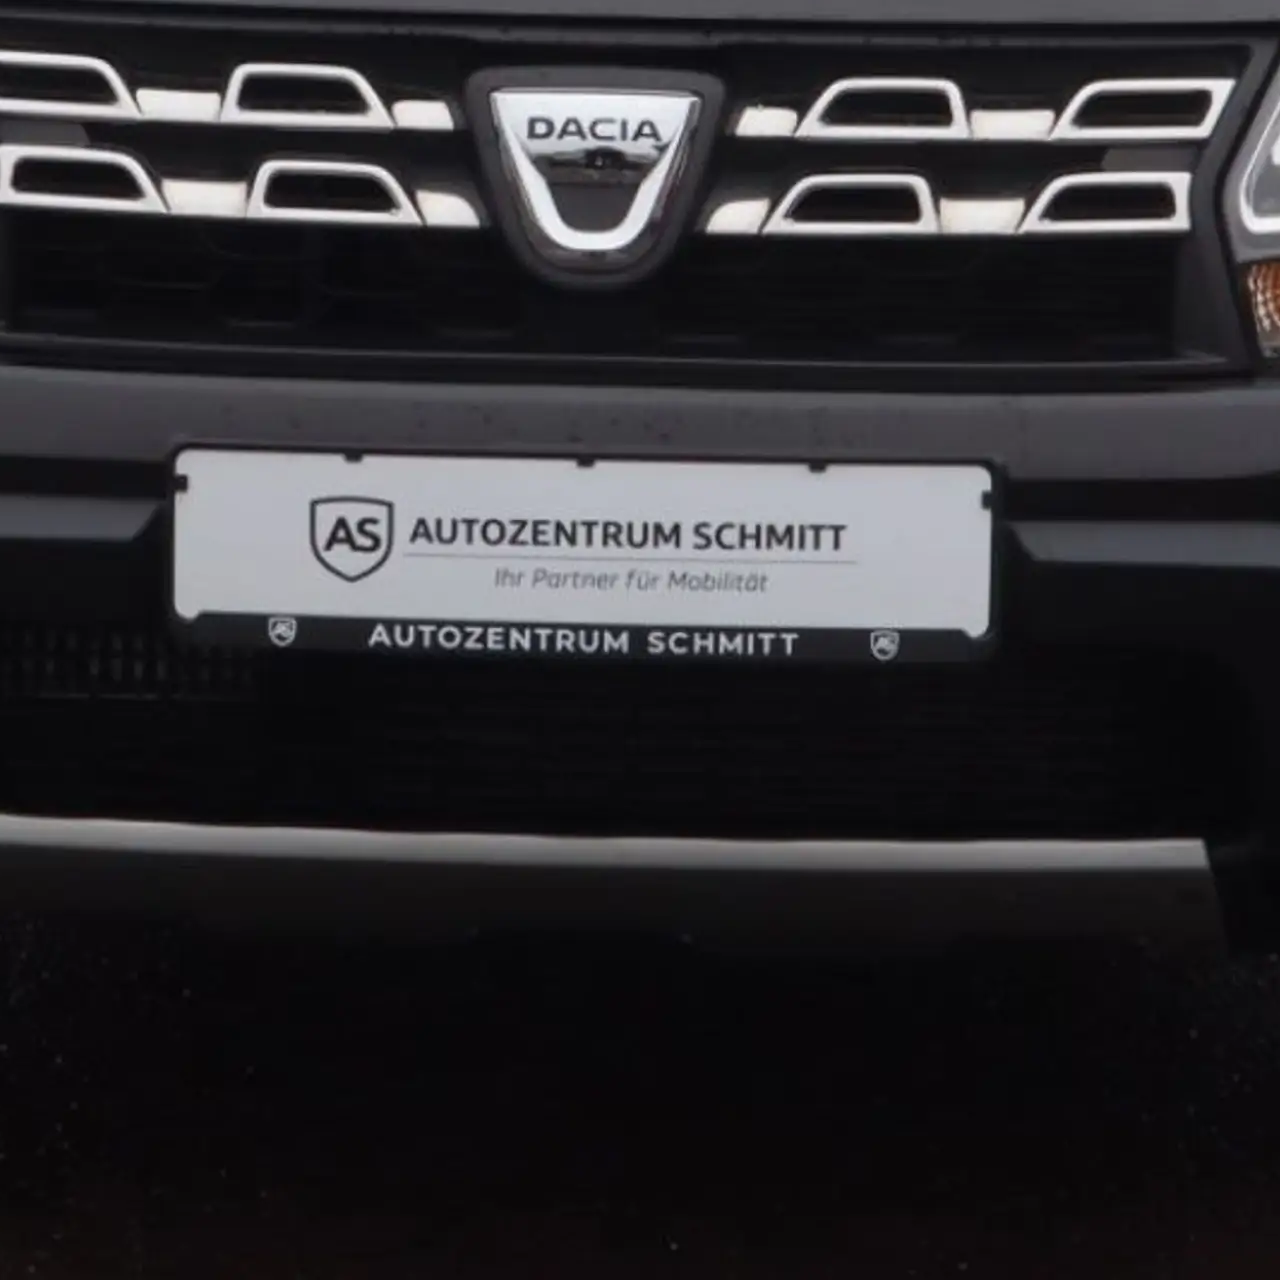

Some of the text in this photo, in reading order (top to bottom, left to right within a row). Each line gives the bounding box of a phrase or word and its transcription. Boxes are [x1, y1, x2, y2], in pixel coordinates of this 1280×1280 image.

[527, 116, 662, 142] DACIA
[324, 516, 382, 553] AS
[409, 518, 847, 551] AUTOZENTRUM SCHMITT
[494, 568, 769, 593] Ihr Partner für Mobilität
[368, 624, 799, 656] AUTOZENTRUM SCHMITT
